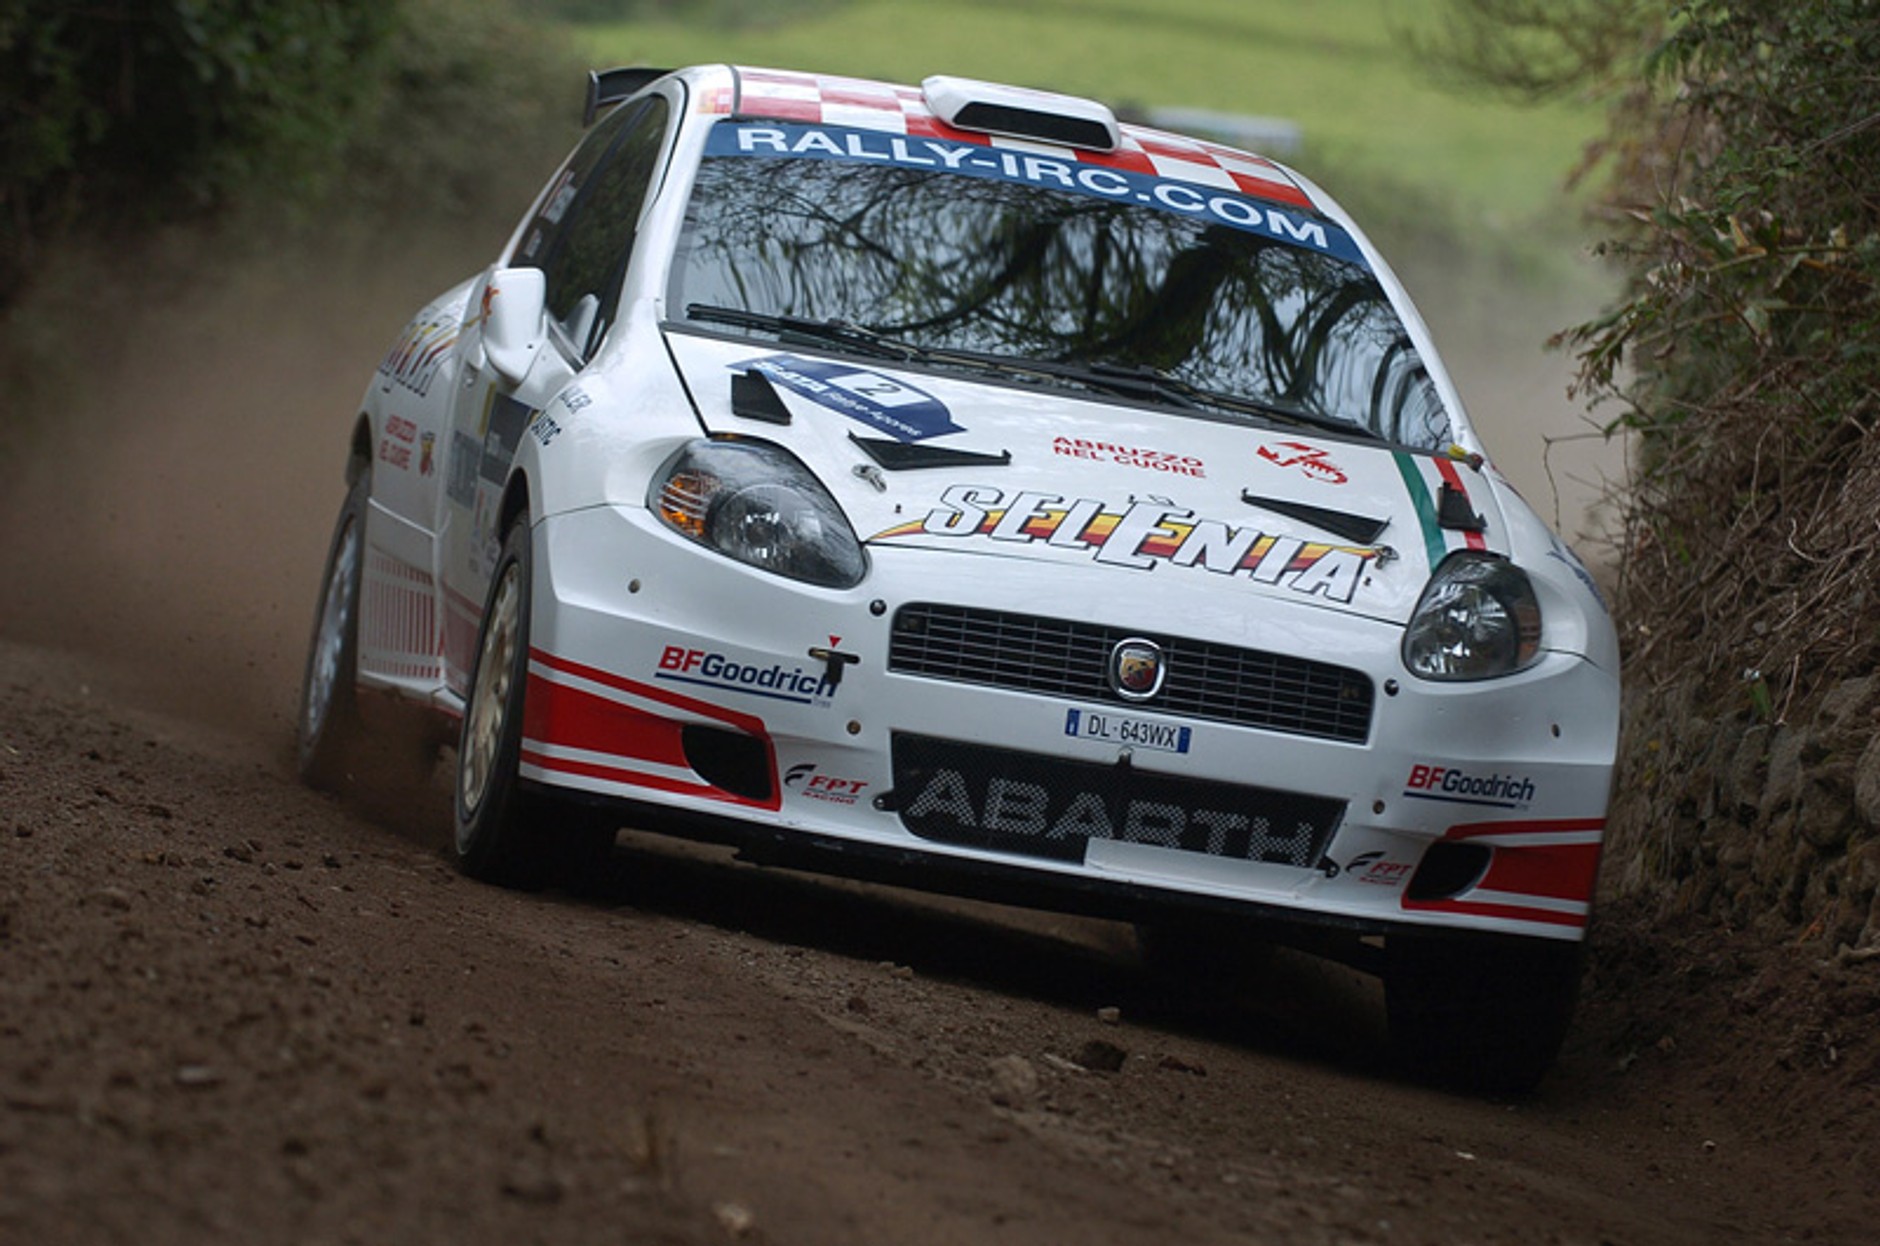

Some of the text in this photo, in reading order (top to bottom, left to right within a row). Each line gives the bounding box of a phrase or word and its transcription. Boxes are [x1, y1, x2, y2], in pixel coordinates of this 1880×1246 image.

[738, 128, 1329, 248] RALLY-IRC.COM
[855, 382, 901, 397] 2
[1053, 436, 1203, 467] ABRUZZO
[1054, 446, 1207, 478] NEL CUORE
[657, 644, 840, 698] BFGoodrich
[1407, 763, 1536, 801] BFGoodrich
[905, 767, 1313, 867] ABARTH
